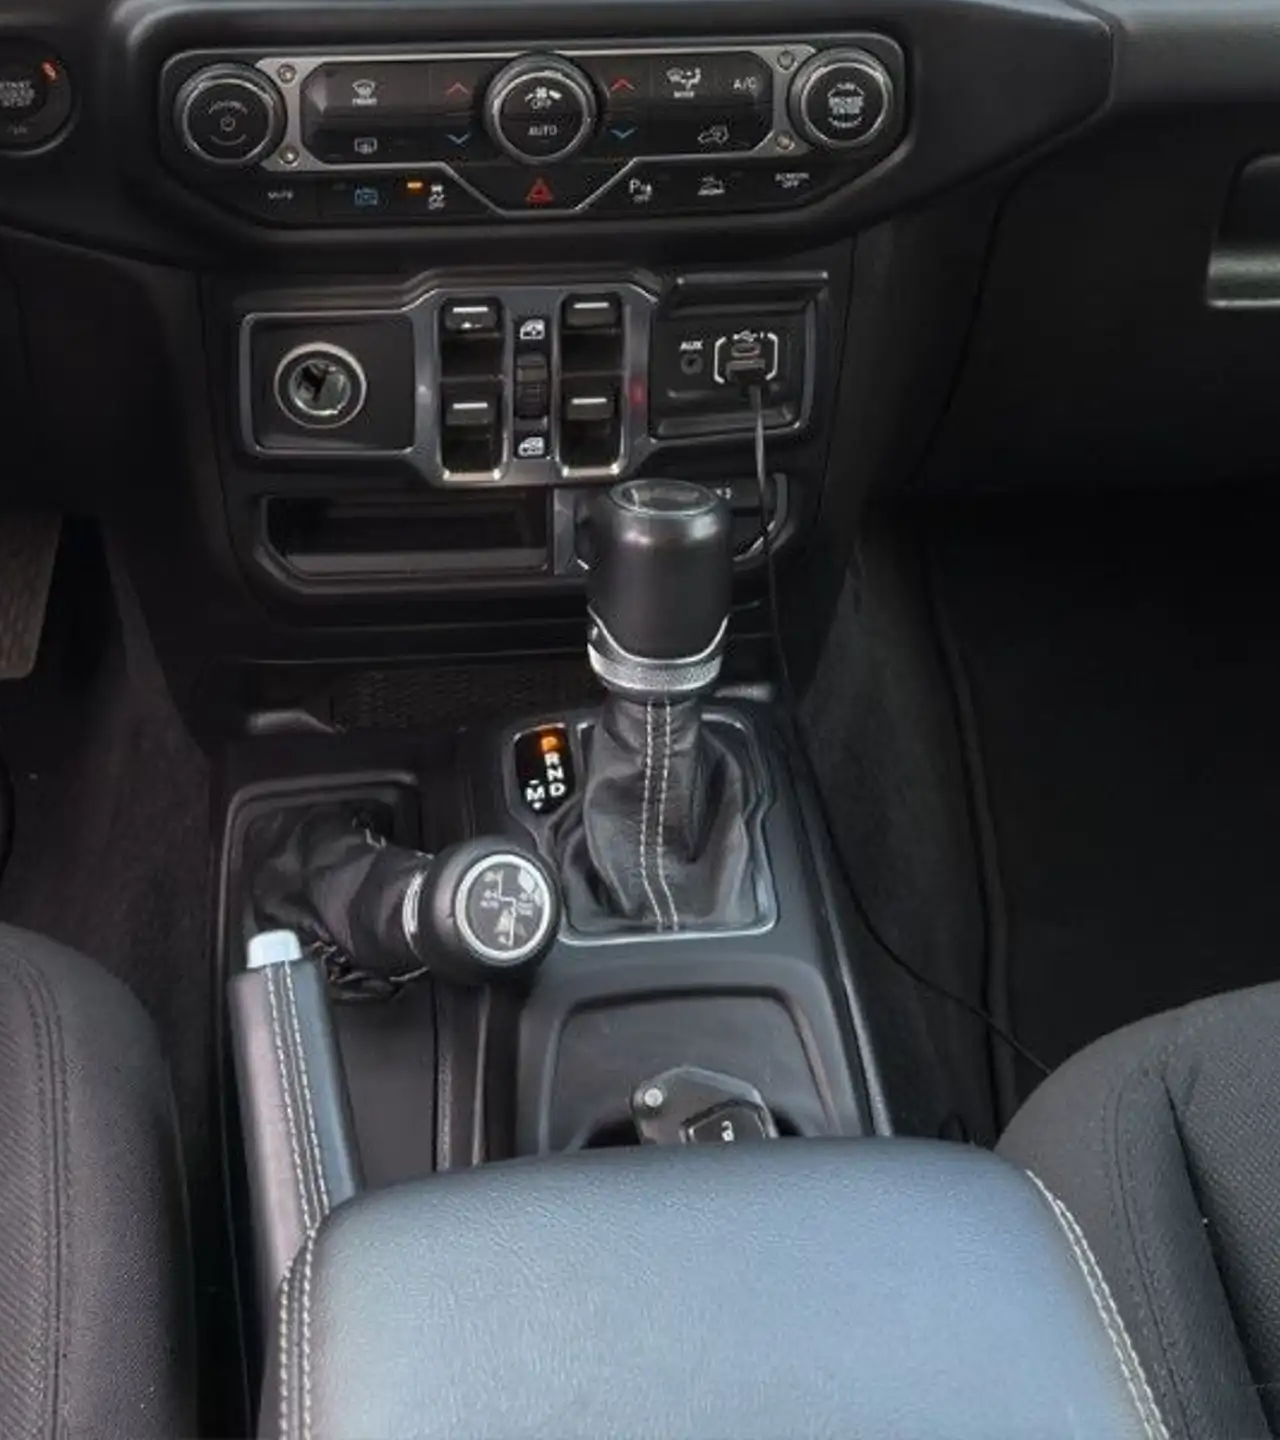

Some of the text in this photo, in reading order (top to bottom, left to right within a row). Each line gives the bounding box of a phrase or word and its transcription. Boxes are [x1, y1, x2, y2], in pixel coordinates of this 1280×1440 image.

[733, 76, 758, 91] A/C
[527, 123, 558, 137] AUTO
[679, 340, 704, 350] AUX
[544, 751, 560, 766] R
[546, 767, 563, 783] N
[525, 786, 544, 802] M
[549, 784, 565, 798] D
